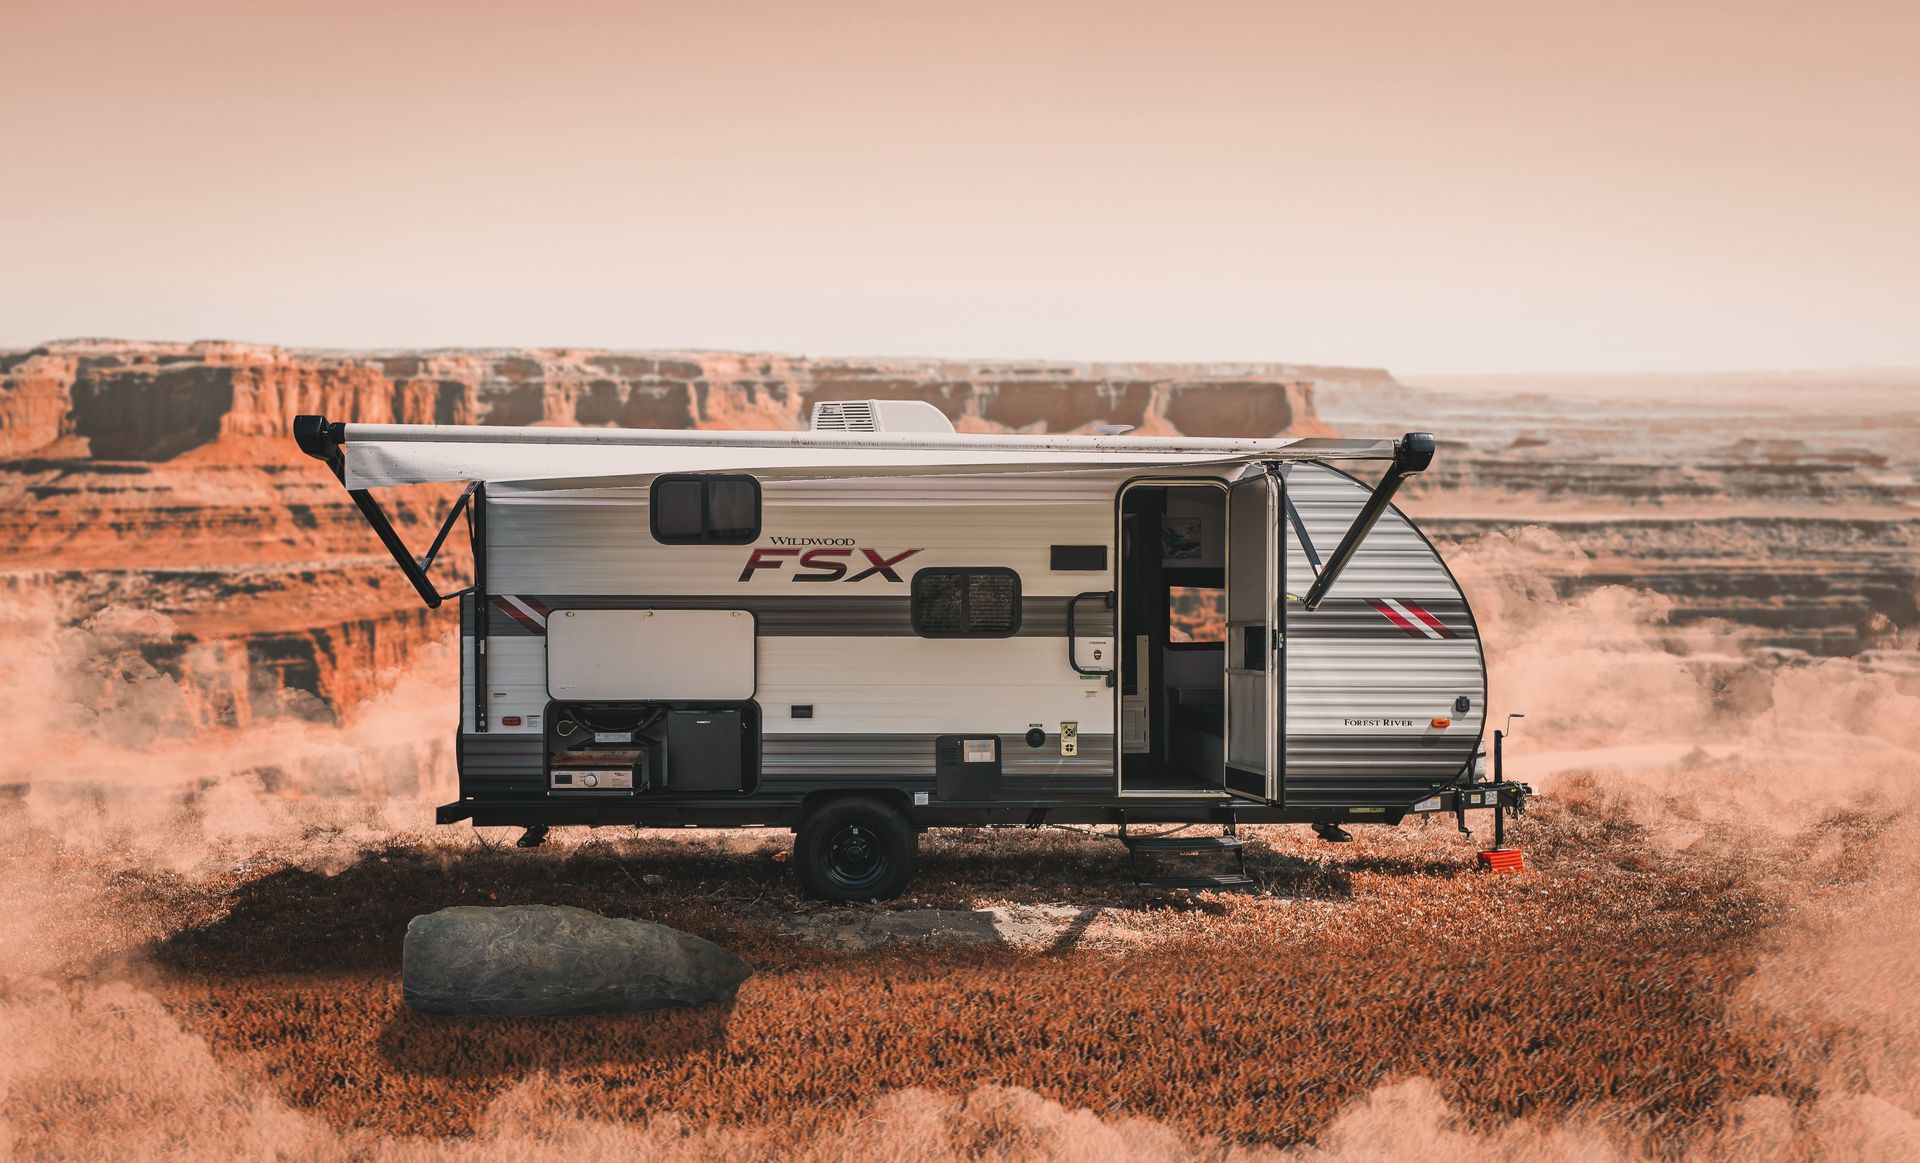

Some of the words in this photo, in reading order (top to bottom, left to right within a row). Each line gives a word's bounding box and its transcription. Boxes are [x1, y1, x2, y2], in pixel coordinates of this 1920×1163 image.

[770, 536, 855, 546] WILDWOOD
[738, 548, 925, 582] FSX
[1344, 718, 1380, 726] FOREST
[1383, 718, 1413, 726] RIVER
